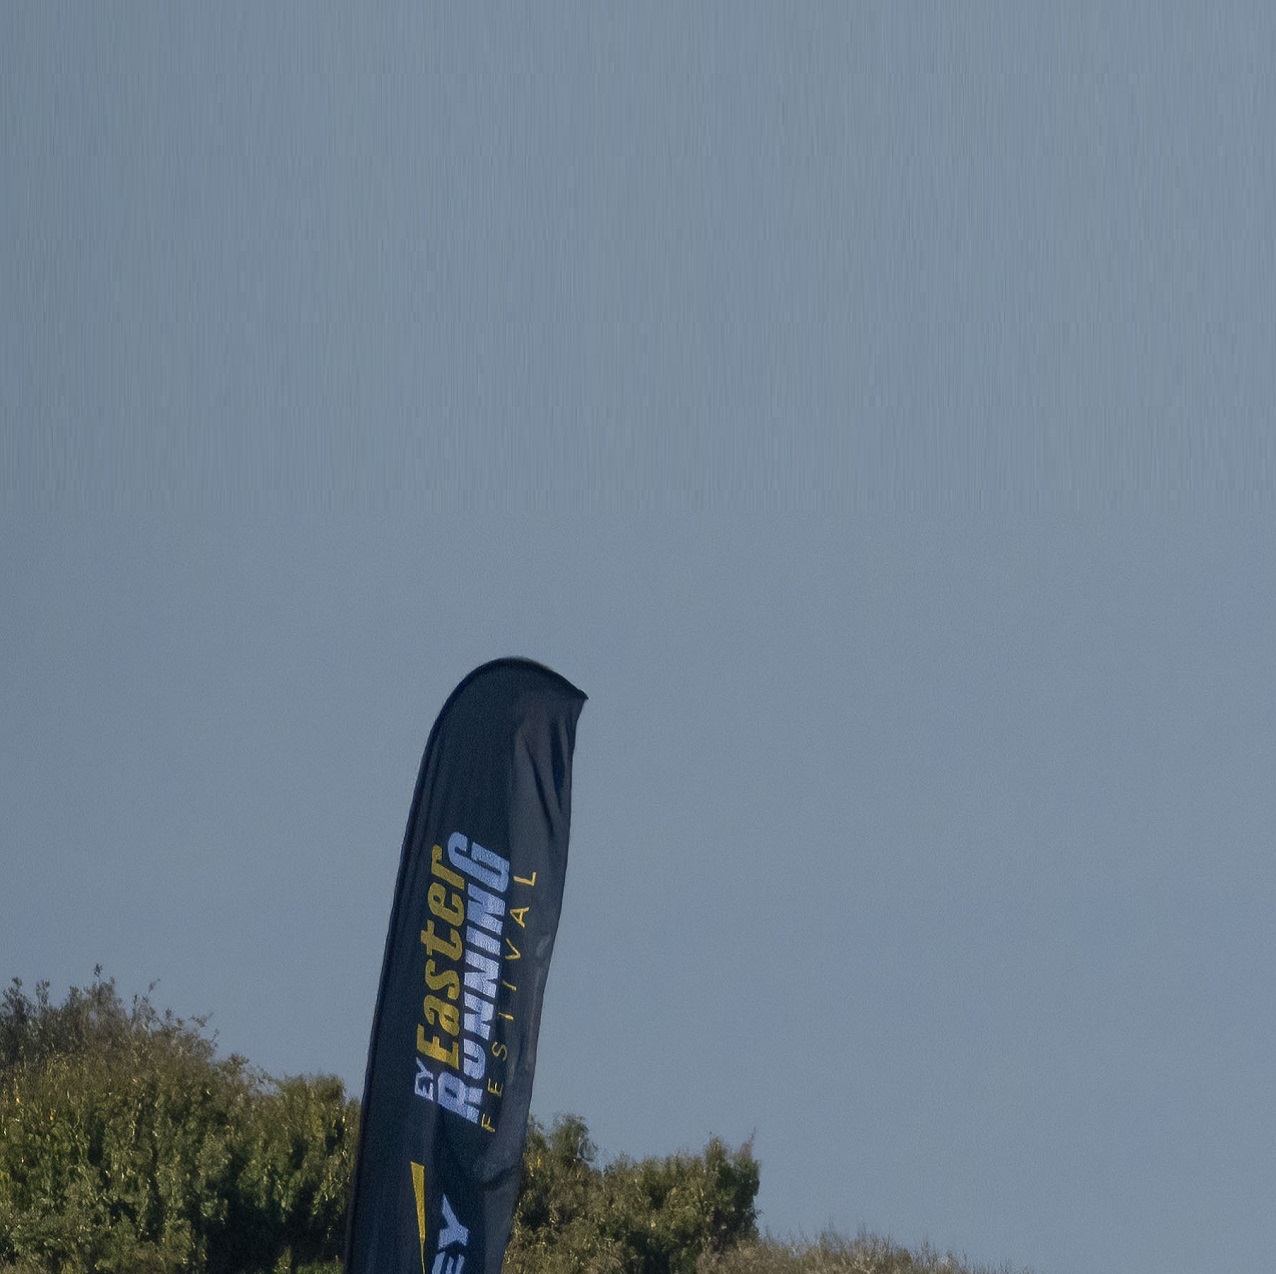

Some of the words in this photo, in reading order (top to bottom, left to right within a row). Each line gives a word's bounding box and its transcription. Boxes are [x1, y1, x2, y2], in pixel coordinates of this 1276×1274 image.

[416, 844, 465, 1070] Easter
[437, 831, 510, 1124] RUNNING
[481, 871, 537, 1134] FESTIVAL
